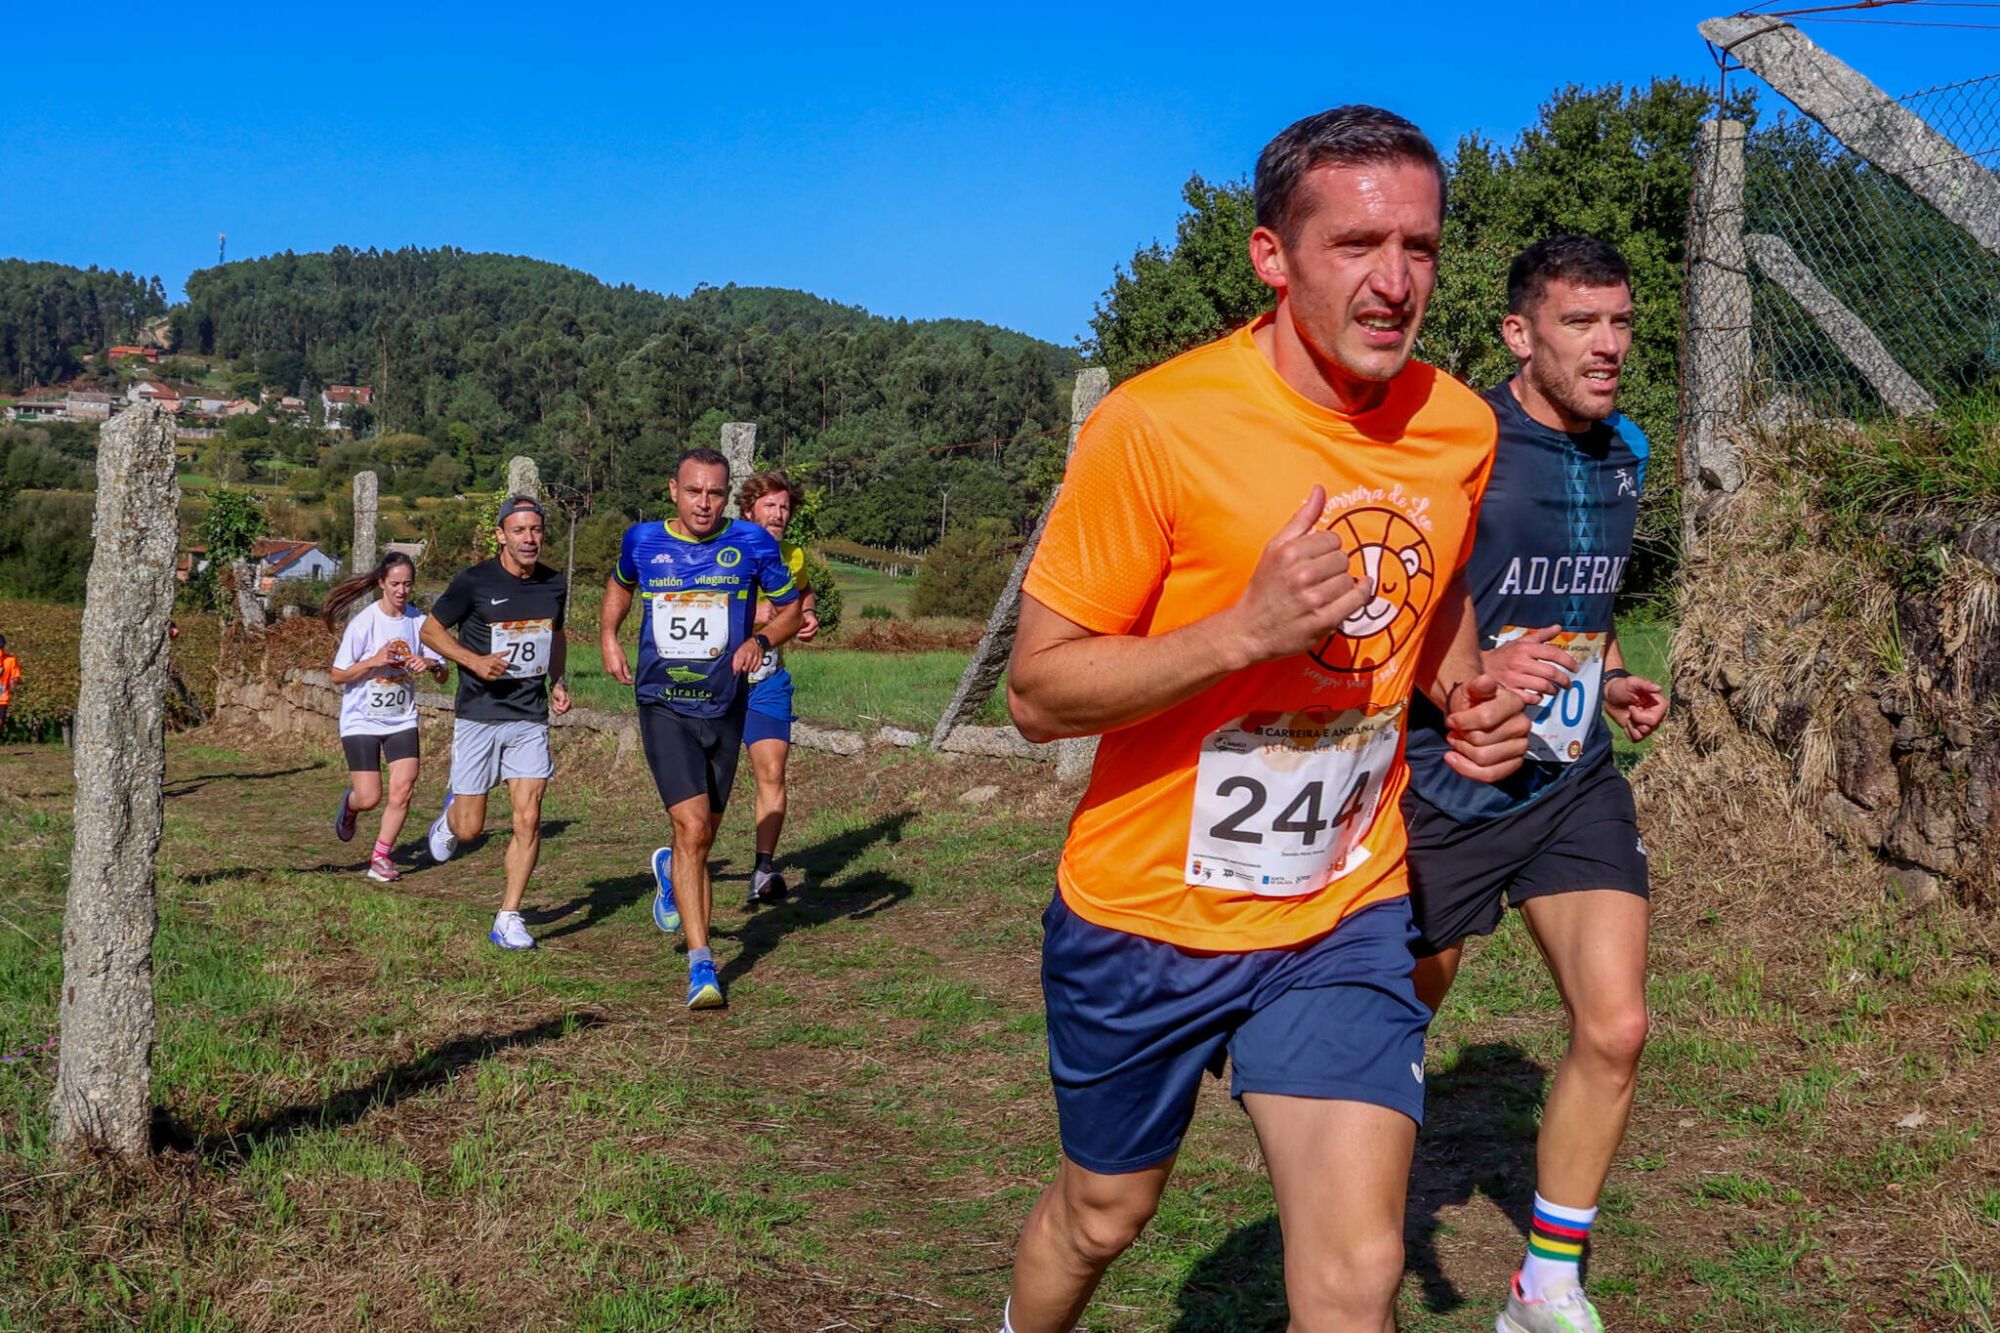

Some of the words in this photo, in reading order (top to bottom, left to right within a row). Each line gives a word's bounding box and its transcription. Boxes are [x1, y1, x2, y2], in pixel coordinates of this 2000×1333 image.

[649, 575, 684, 587] triatlón
[694, 574, 740, 587] vilagarcía
[1551, 556, 1630, 595] CERN
[669, 616, 709, 642] 54
[506, 641, 536, 663] 78
[370, 689, 406, 708] 320
[1265, 727, 1321, 738] CARREIRA
[1323, 728, 1330, 737] E
[1331, 723, 1376, 737] ANDAINA
[1209, 769, 1372, 846] 244
